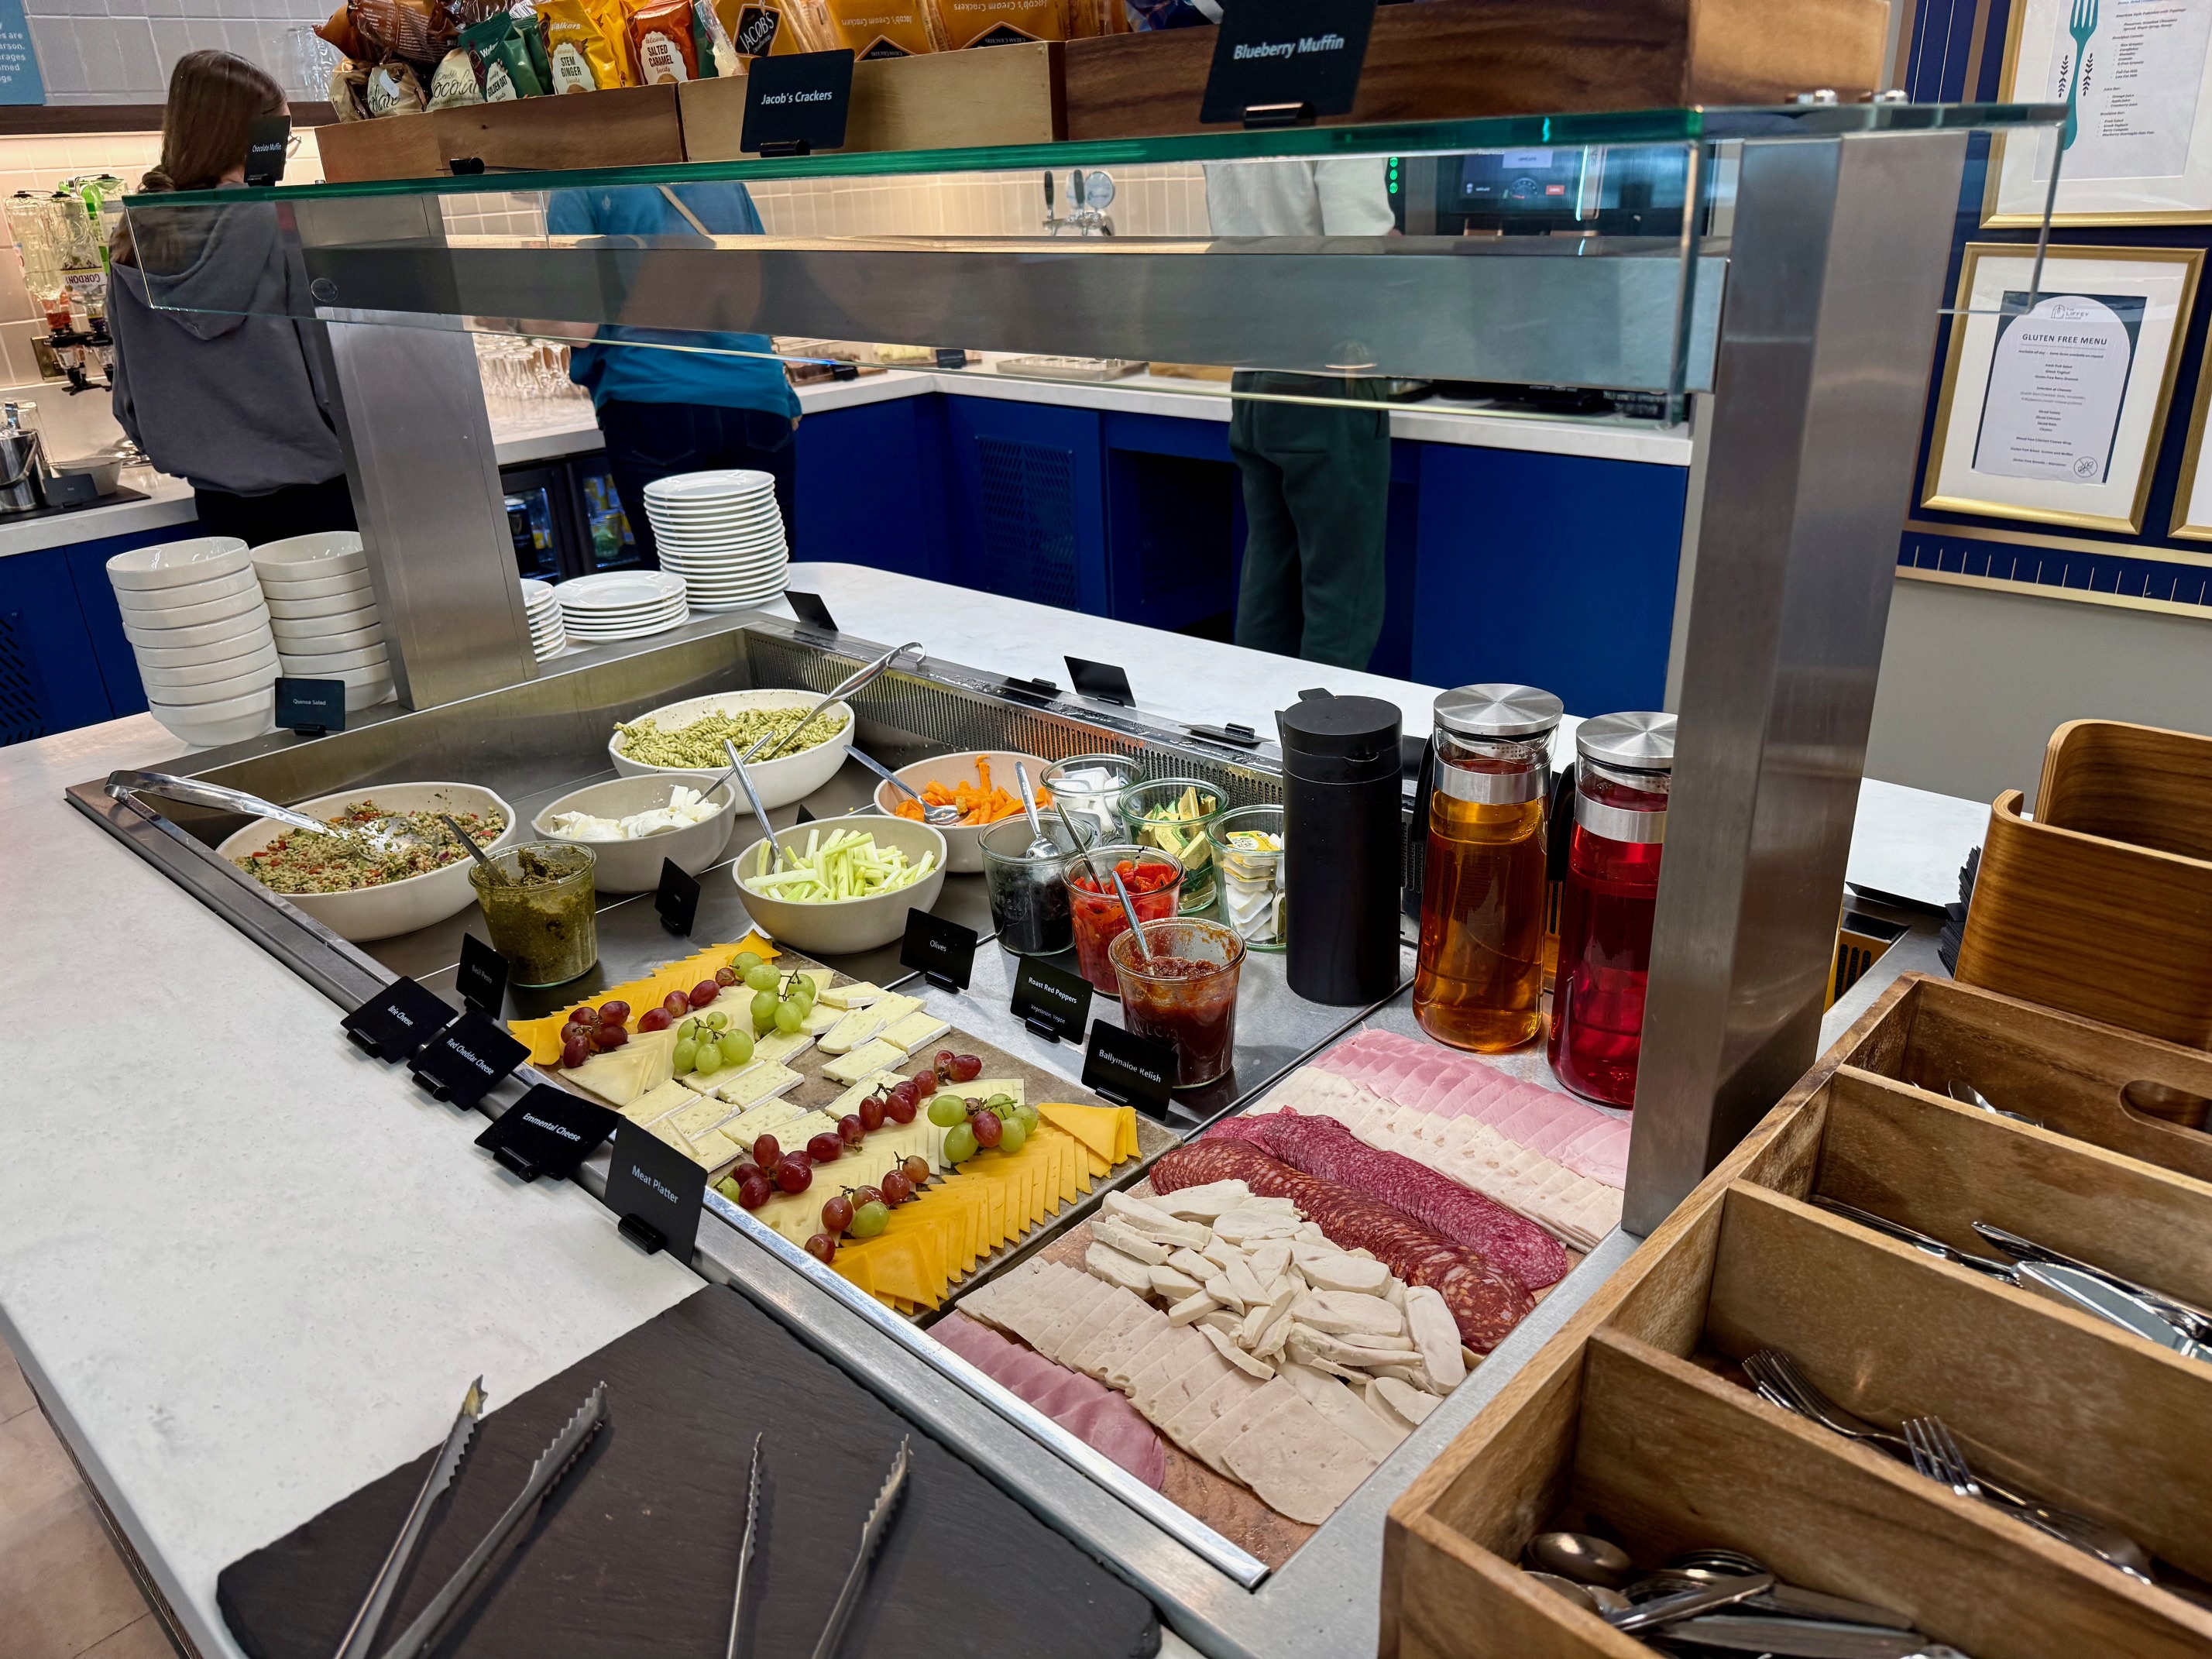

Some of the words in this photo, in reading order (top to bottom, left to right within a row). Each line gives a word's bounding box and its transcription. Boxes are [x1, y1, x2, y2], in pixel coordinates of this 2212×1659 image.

[647, 44, 668, 57] SALTED
[1233, 42, 1296, 60] Blueberry
[1297, 34, 1345, 53] Muffin
[560, 57, 575, 67] STEM
[648, 55, 674, 67] CARAMEL
[561, 67, 582, 77] GINGER
[761, 92, 794, 105] Jacob's
[795, 90, 833, 103] Crackers
[2022, 333, 2055, 342] GLUTEN
[2057, 335, 2078, 344] FREE
[2080, 337, 2107, 345] MENU
[929, 939, 947, 952] Olives
[472, 964, 482, 976] Basil
[481, 970, 493, 984] Pesto
[1029, 977, 1043, 989] Roast
[1043, 984, 1055, 994] Red
[1055, 988, 1077, 1004] Peppers
[387, 1005, 399, 1016] Brie
[397, 1012, 414, 1027] Cheese
[446, 1038, 460, 1049] Red
[455, 1044, 477, 1063] Cheddar
[475, 1059, 494, 1075] Cheese
[1099, 1049, 1138, 1073] Ballymaloe
[1139, 1067, 1161, 1084] Relish
[522, 1112, 559, 1132] Emmental
[555, 1126, 581, 1142] Cheese
[632, 1164, 652, 1187] Meat
[652, 1180, 679, 1204] Platter
